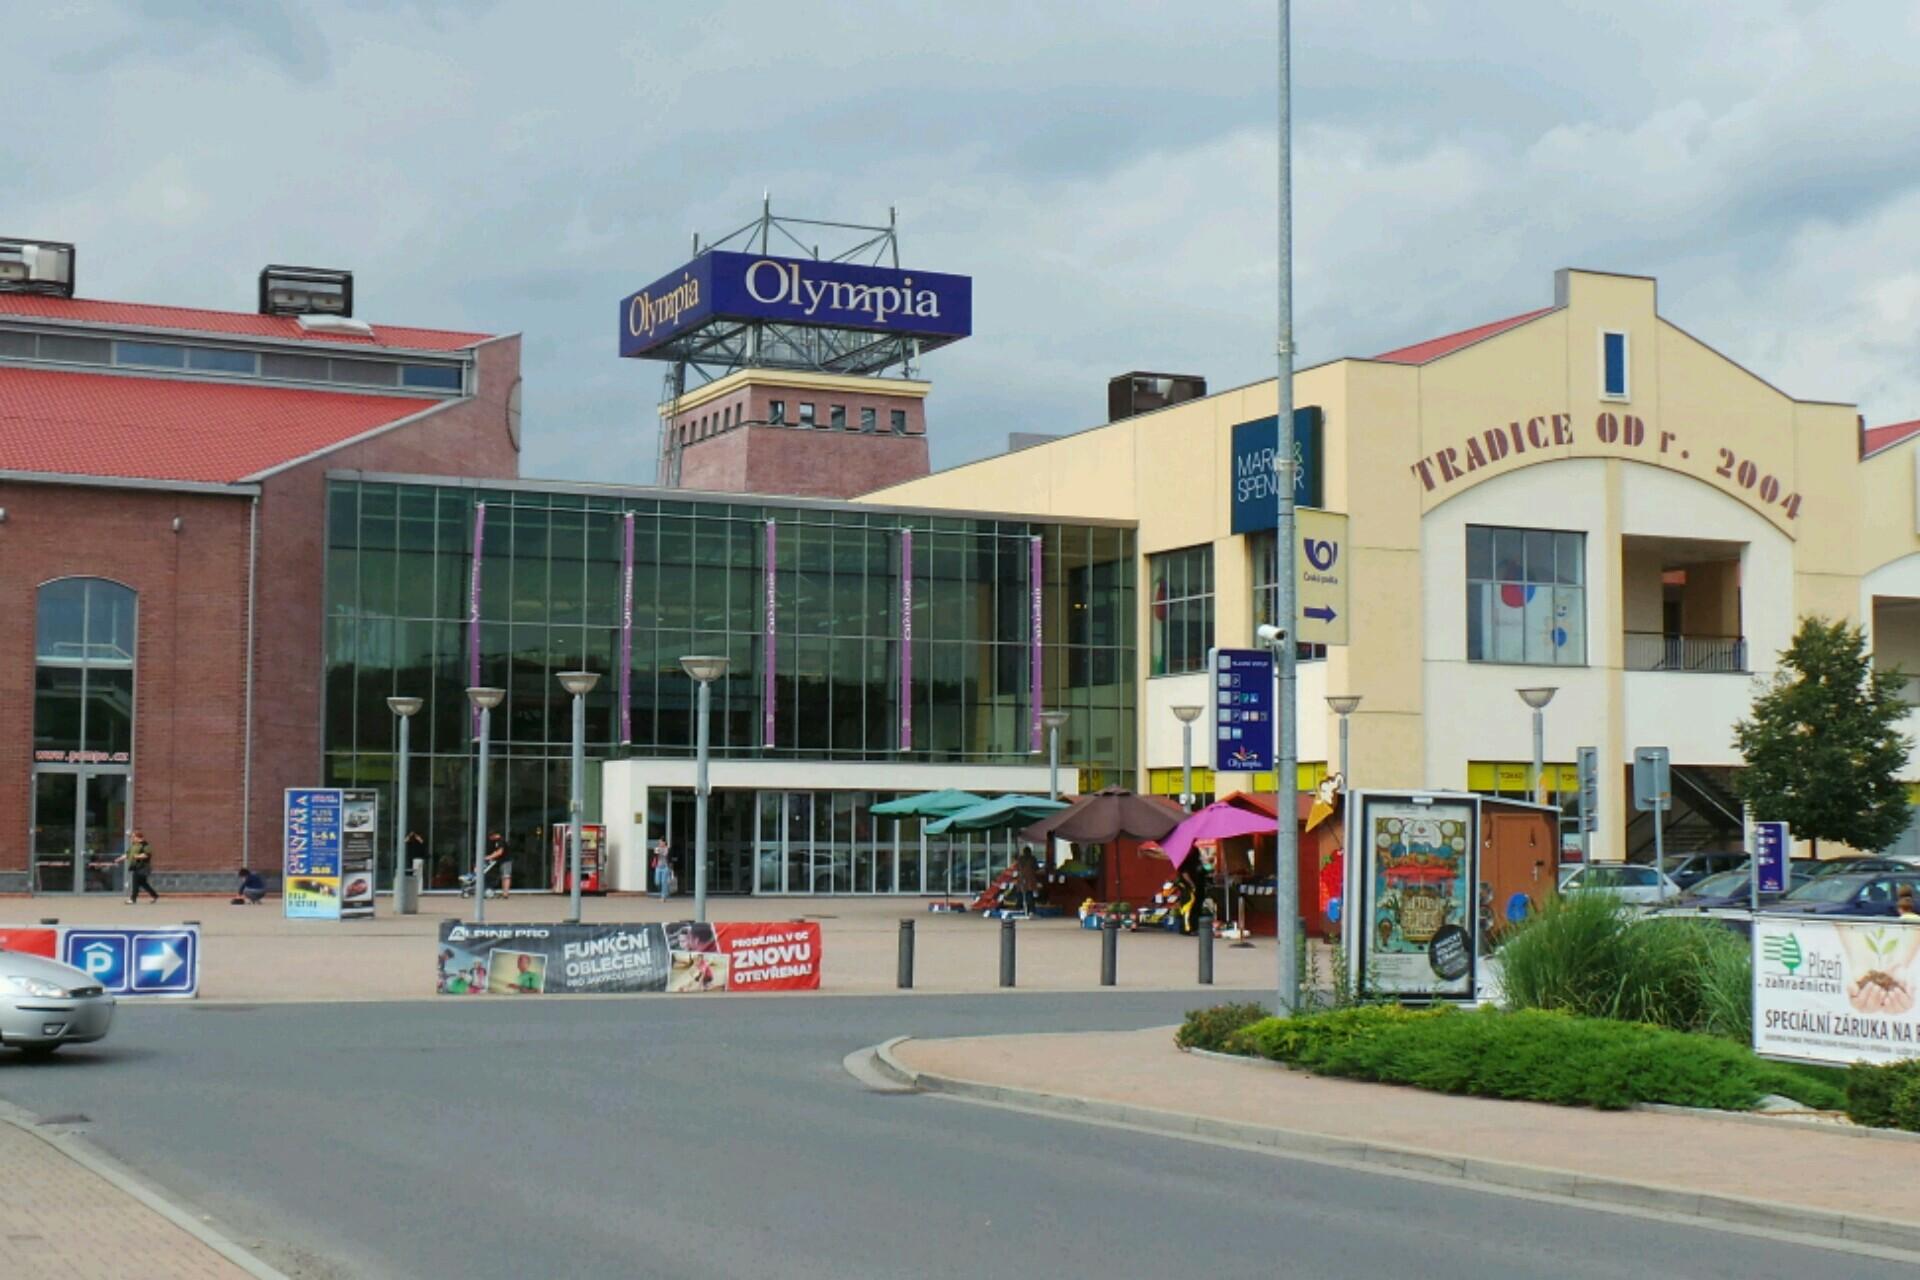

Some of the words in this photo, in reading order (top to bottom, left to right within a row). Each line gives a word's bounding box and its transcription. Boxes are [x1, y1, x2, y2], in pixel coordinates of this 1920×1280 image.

[629, 272, 699, 337] Olympia
[745, 260, 940, 323] Olympia
[1410, 413, 1574, 492] TRADICE
[1596, 412, 1644, 447] OD
[1660, 430, 1689, 459] r.
[1716, 447, 1802, 521] 2004
[1238, 466, 1304, 503] SPENR
[514, 929, 550, 939] PRO
[564, 928, 649, 960] FUNKČNÍ
[566, 947, 652, 977] OBLEČENÍ
[733, 943, 811, 969] ZNOVU
[1808, 951, 1842, 981] Plzeň
[734, 963, 813, 985] OTEVŘENA!
[1765, 1008, 1830, 1034] SPECIÁLNÍ
[1834, 1012, 1889, 1041] ZÁRUKA
[1892, 1022, 1913, 1042] NA
